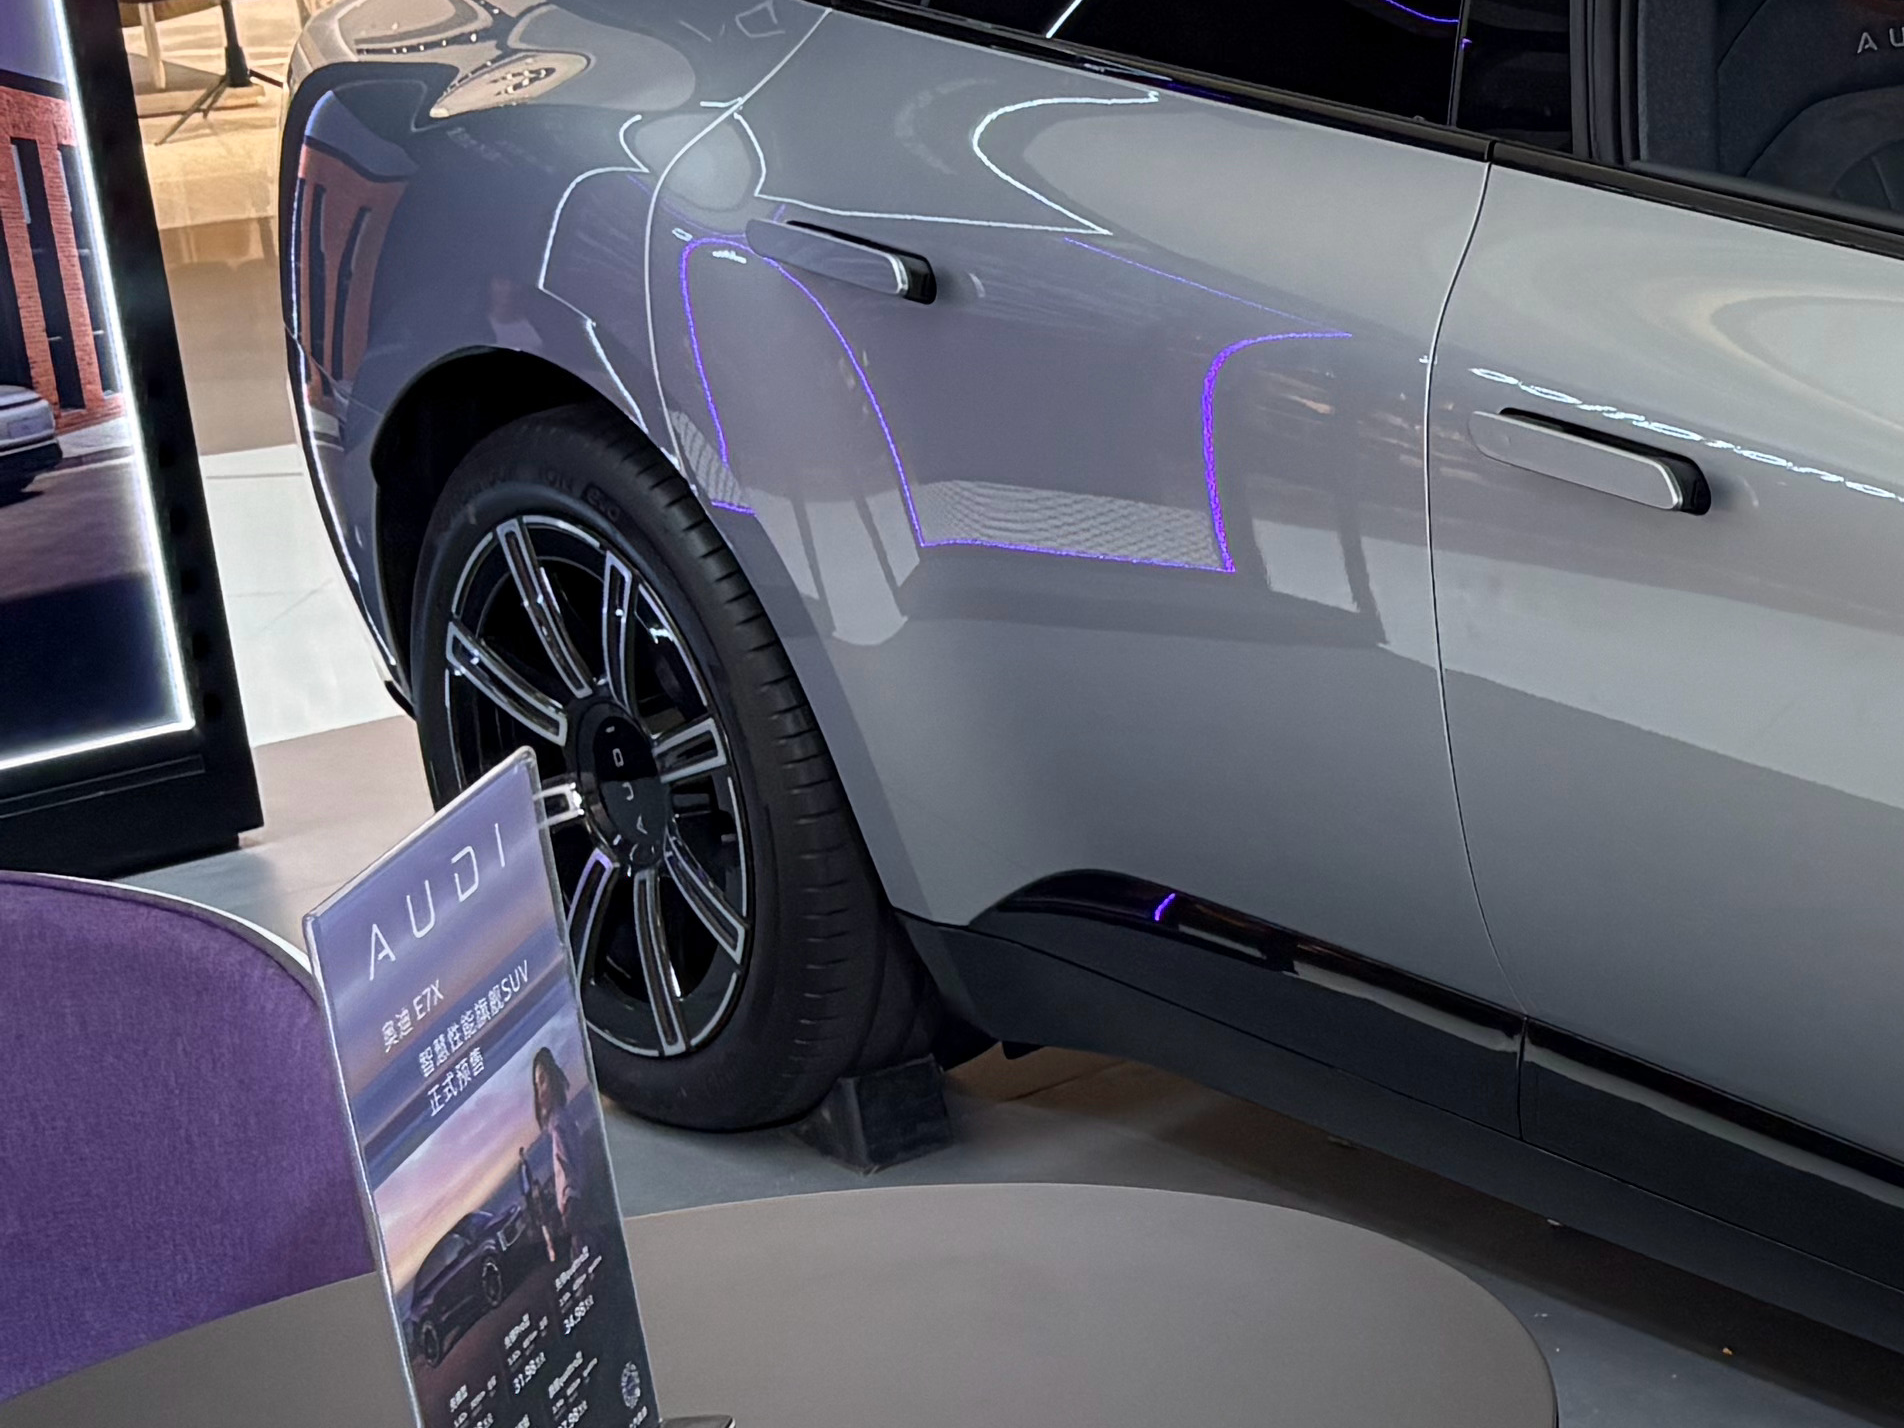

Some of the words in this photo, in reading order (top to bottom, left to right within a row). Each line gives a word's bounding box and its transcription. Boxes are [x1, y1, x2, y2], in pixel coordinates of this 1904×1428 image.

[369, 822, 506, 982] AUDI
[381, 1006, 414, 1053] 奥迪
[412, 979, 445, 1022] E7X
[418, 959, 530, 1079] 智慧性能旗舰SUV
[427, 1046, 485, 1117] 正式预售
